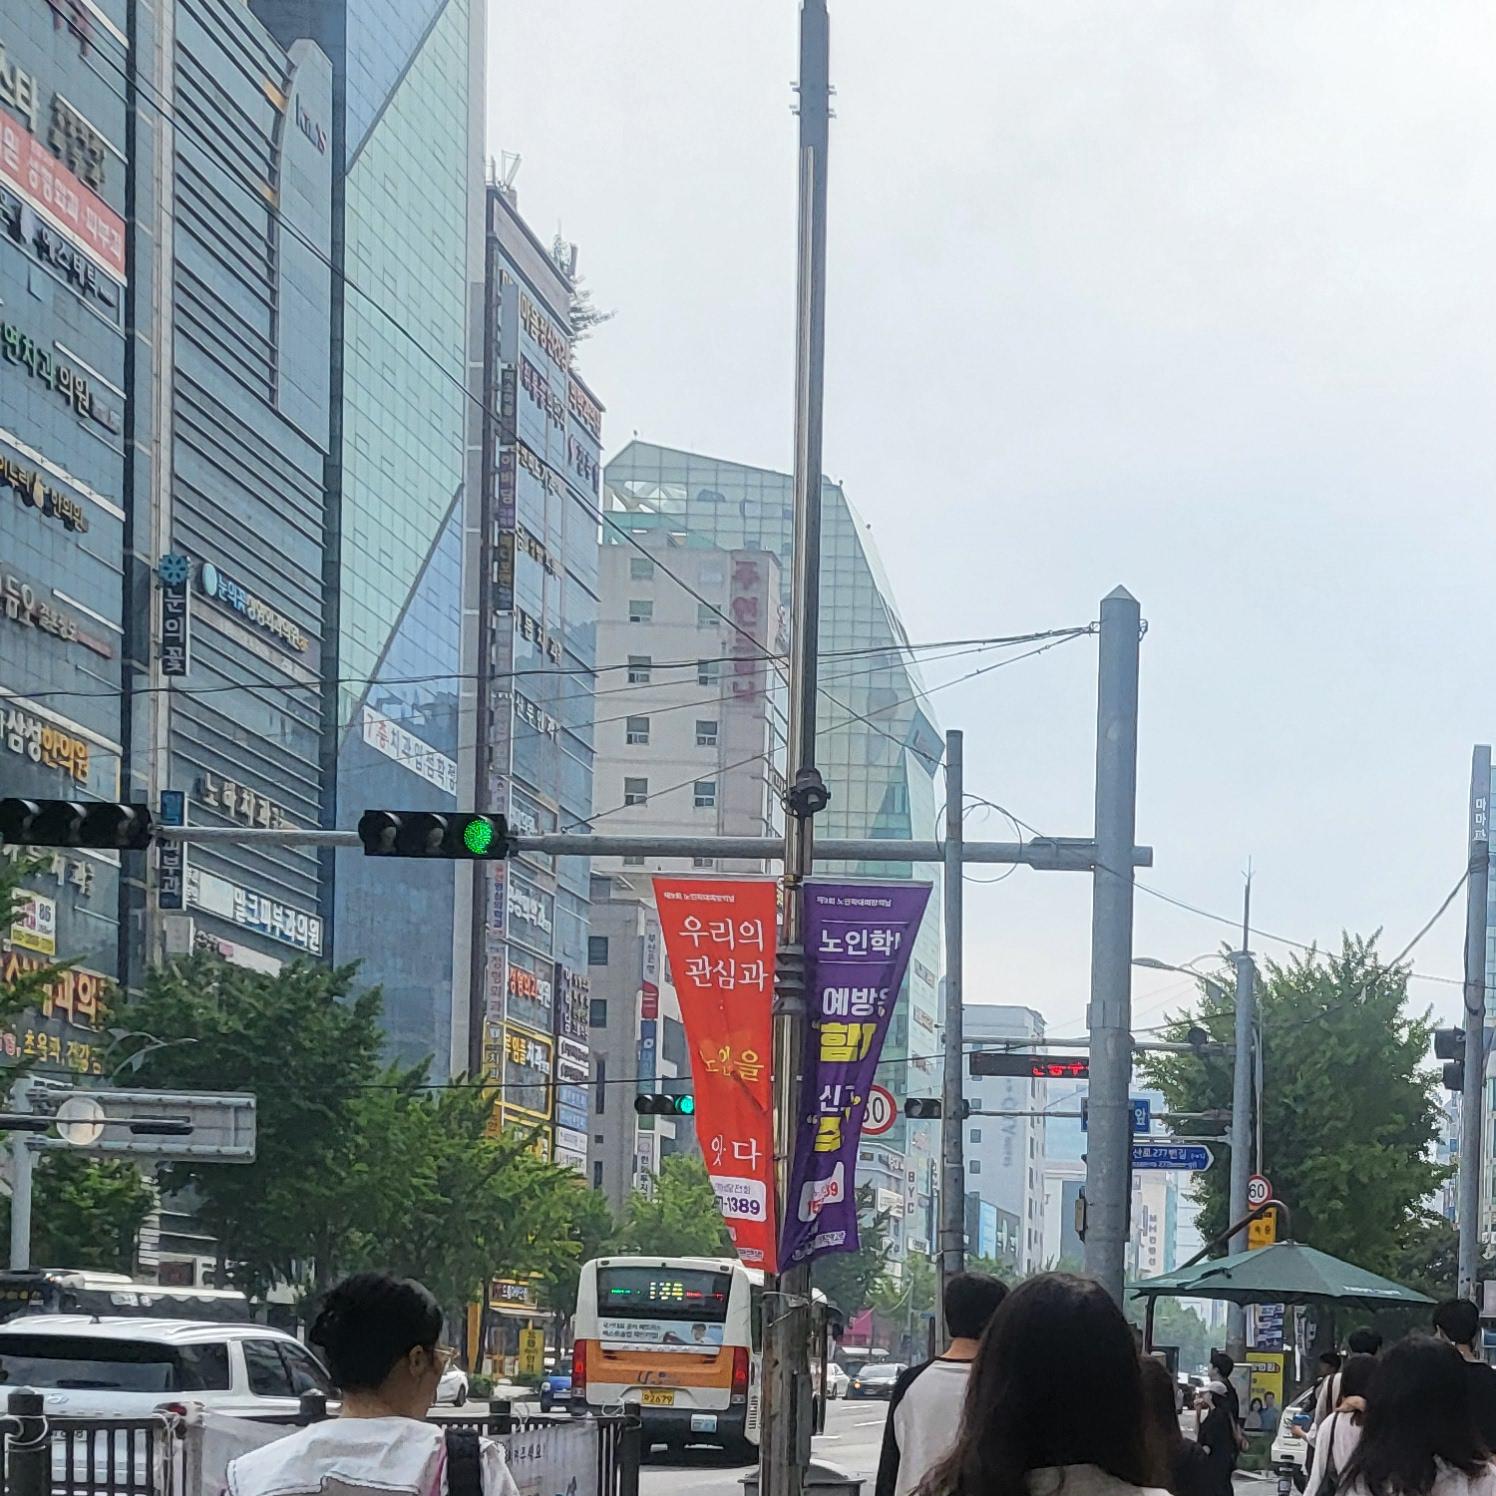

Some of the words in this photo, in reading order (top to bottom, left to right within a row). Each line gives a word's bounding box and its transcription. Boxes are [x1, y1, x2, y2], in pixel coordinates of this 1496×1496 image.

[679, 915, 765, 952] 우리의
[685, 956, 769, 991] 관심과
[700, 1045, 765, 1083] 노인을
[906, 1172, 916, 1215] BYC
[1248, 1183, 1265, 1199] 60
